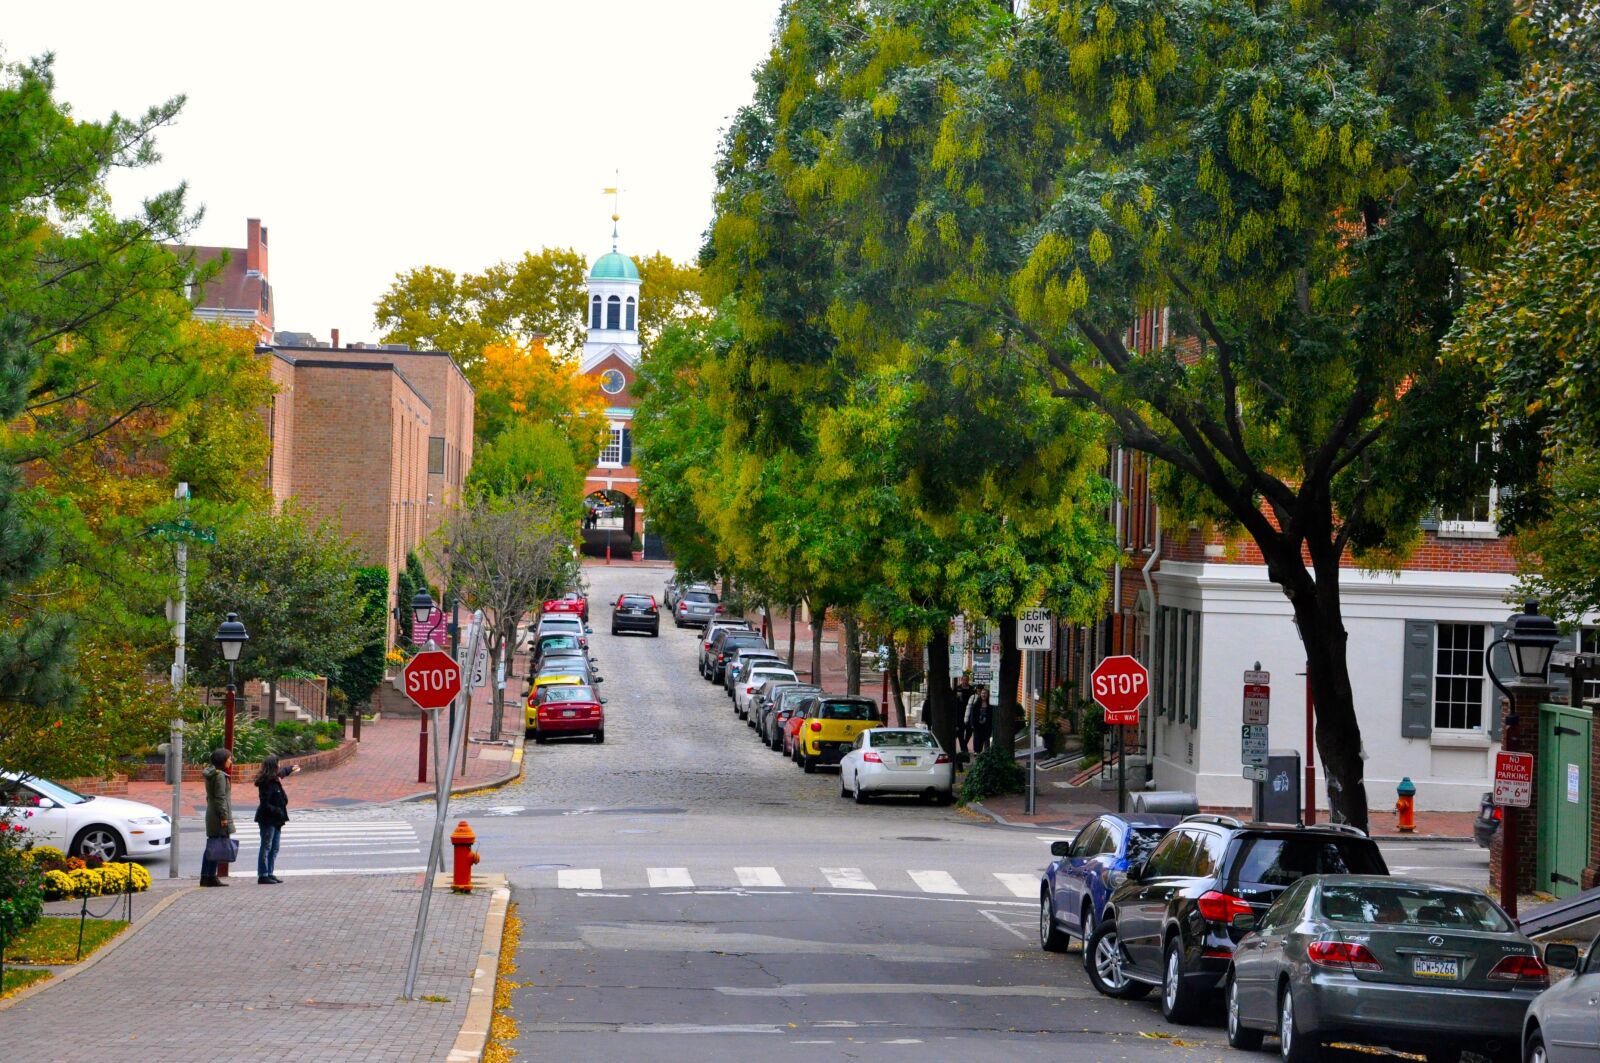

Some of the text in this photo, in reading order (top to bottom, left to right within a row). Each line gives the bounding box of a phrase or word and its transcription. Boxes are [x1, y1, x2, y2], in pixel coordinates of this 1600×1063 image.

[1020, 610, 1050, 620] BEGIN
[1024, 624, 1044, 633] ONE
[1024, 636, 1045, 645] WAY
[408, 669, 456, 692] STOP
[1096, 673, 1144, 696] STOP
[1243, 727, 1249, 737] 2
[1497, 771, 1529, 780] PARKING
